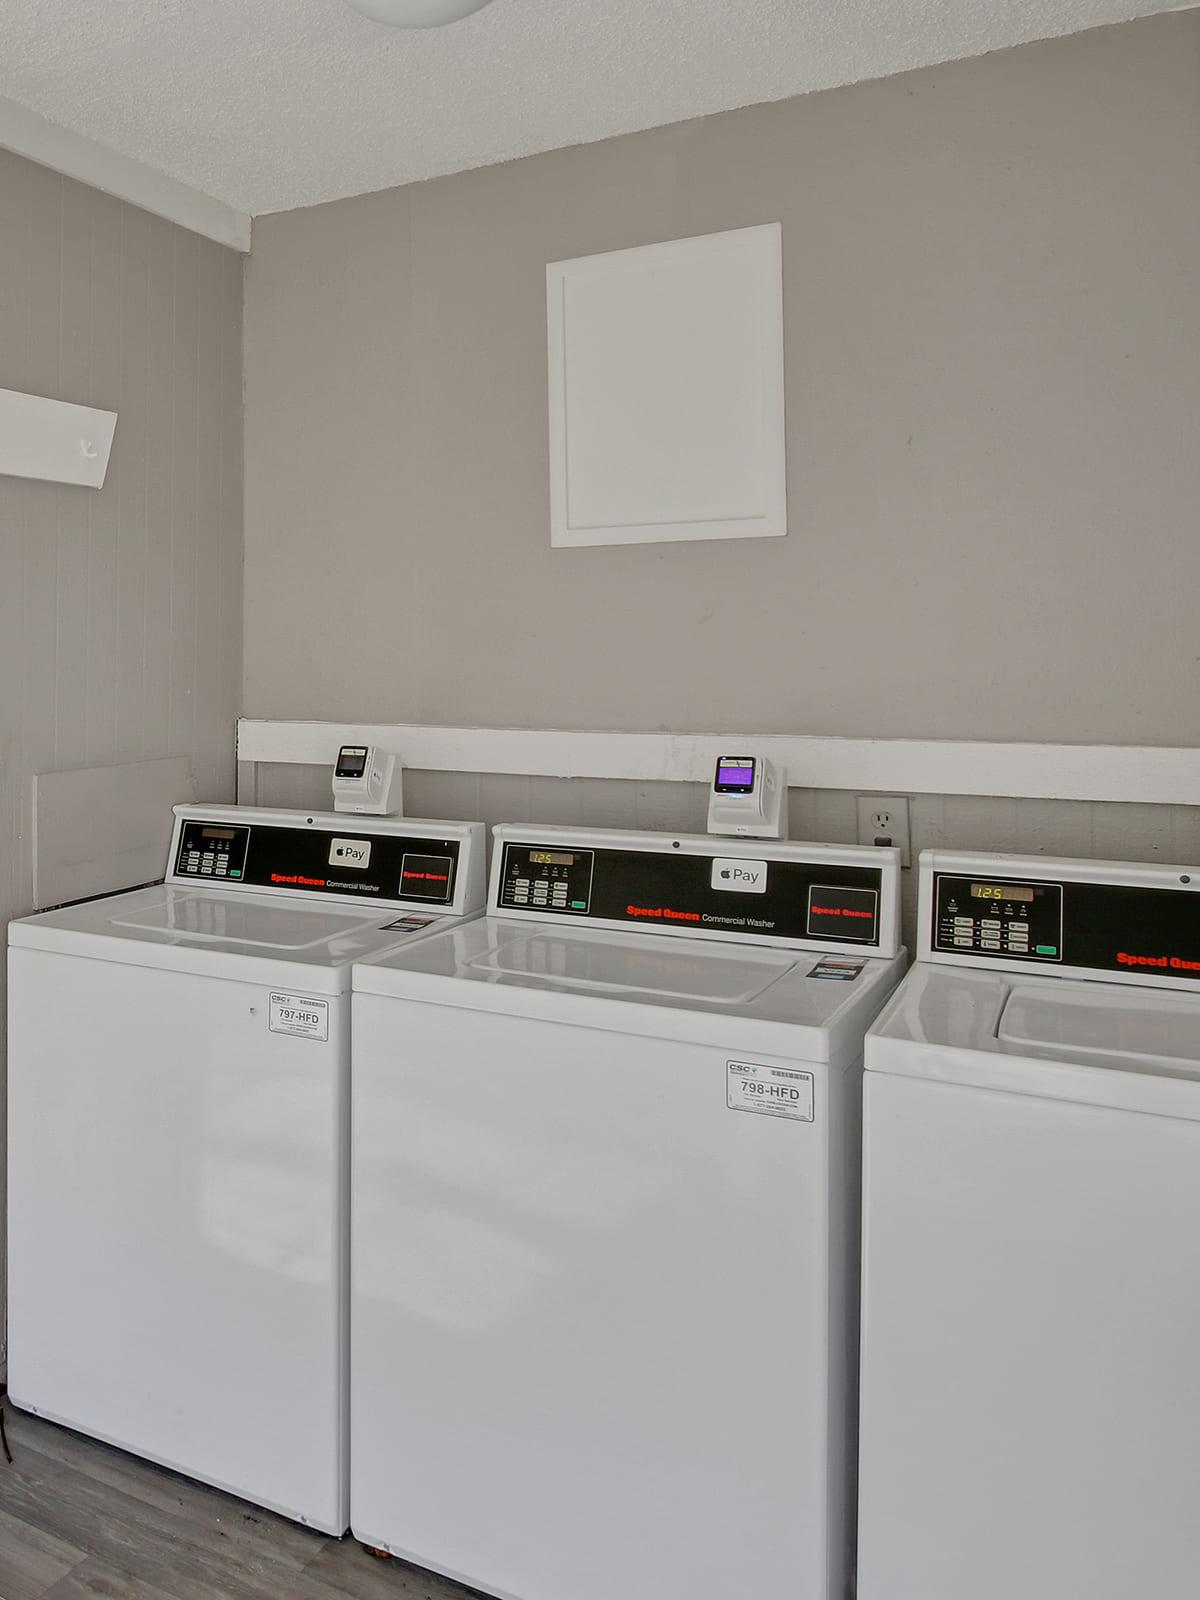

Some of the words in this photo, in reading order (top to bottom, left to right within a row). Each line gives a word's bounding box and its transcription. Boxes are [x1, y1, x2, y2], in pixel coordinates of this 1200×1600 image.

[345, 847, 365, 860] Pay
[271, 873, 298, 883] Speed
[298, 876, 325, 886] Queen
[326, 880, 359, 890] Commercial
[359, 884, 380, 892] Washer
[403, 871, 425, 879] Speed
[425, 873, 448, 881] Queen
[733, 868, 759, 884] Pay
[626, 905, 662, 916] Speed
[662, 908, 700, 920] Queen
[701, 913, 746, 925] Commercial
[746, 918, 776, 928] Washer
[811, 906, 841, 915] Speed
[842, 909, 873, 918] Queen
[1117, 952, 1168, 967] Speed
[279, 1008, 319, 1024] 797-HFD
[729, 1064, 751, 1072] CSC
[741, 1081, 800, 1100] 798-HFD
